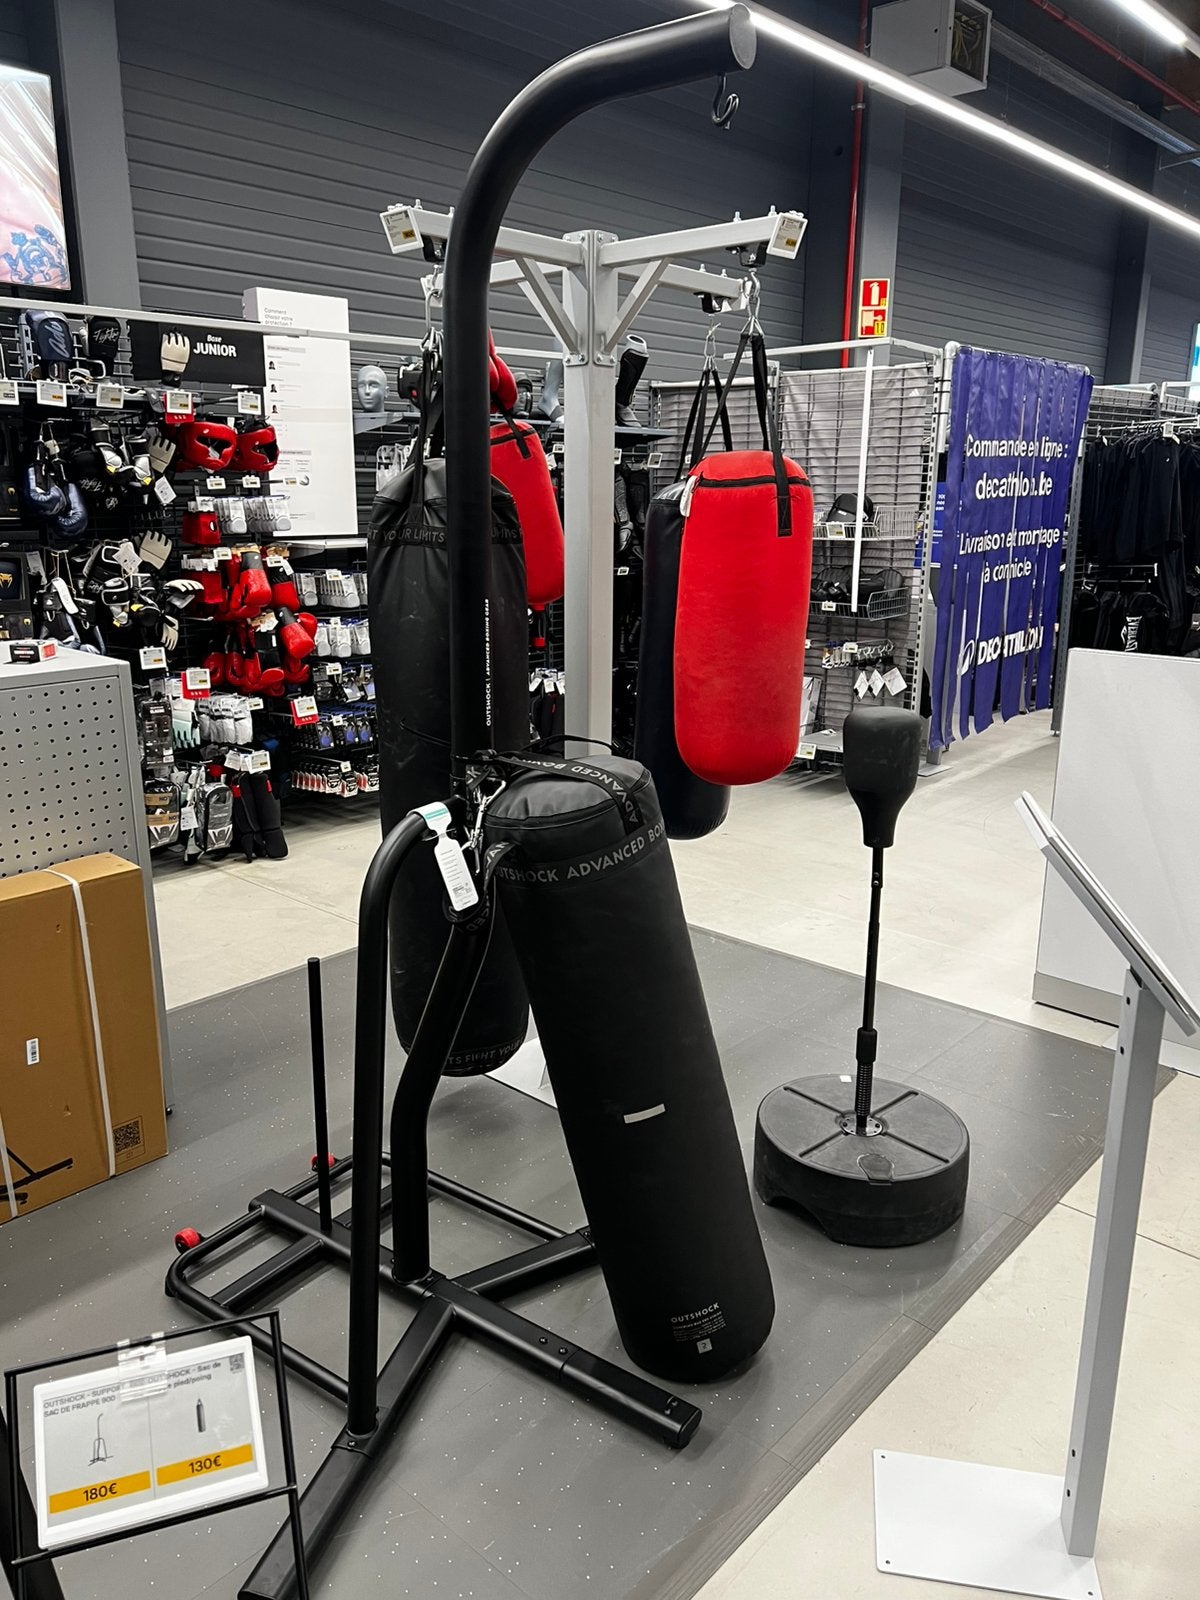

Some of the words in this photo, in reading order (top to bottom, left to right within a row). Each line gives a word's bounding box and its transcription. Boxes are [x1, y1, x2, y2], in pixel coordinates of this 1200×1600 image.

[193, 342, 237, 357] JUNIOR
[1041, 436, 1064, 462] ligne
[975, 471, 1053, 500] decathlon.be
[983, 561, 991, 583] à
[571, 765, 639, 823] ADVANCED
[567, 836, 645, 880] ADVANCED
[671, 1302, 720, 1323] OUTSHOCK
[198, 1364, 211, 1373] Sac
[173, 1374, 212, 1388] pied/poing
[43, 1393, 86, 1409] OUTSHOCK
[43, 1408, 59, 1417] SAC
[60, 1405, 71, 1414] DE
[71, 1399, 100, 1411] FRAPPE
[188, 1455, 222, 1473] 130€
[83, 1482, 118, 1501] 180€
